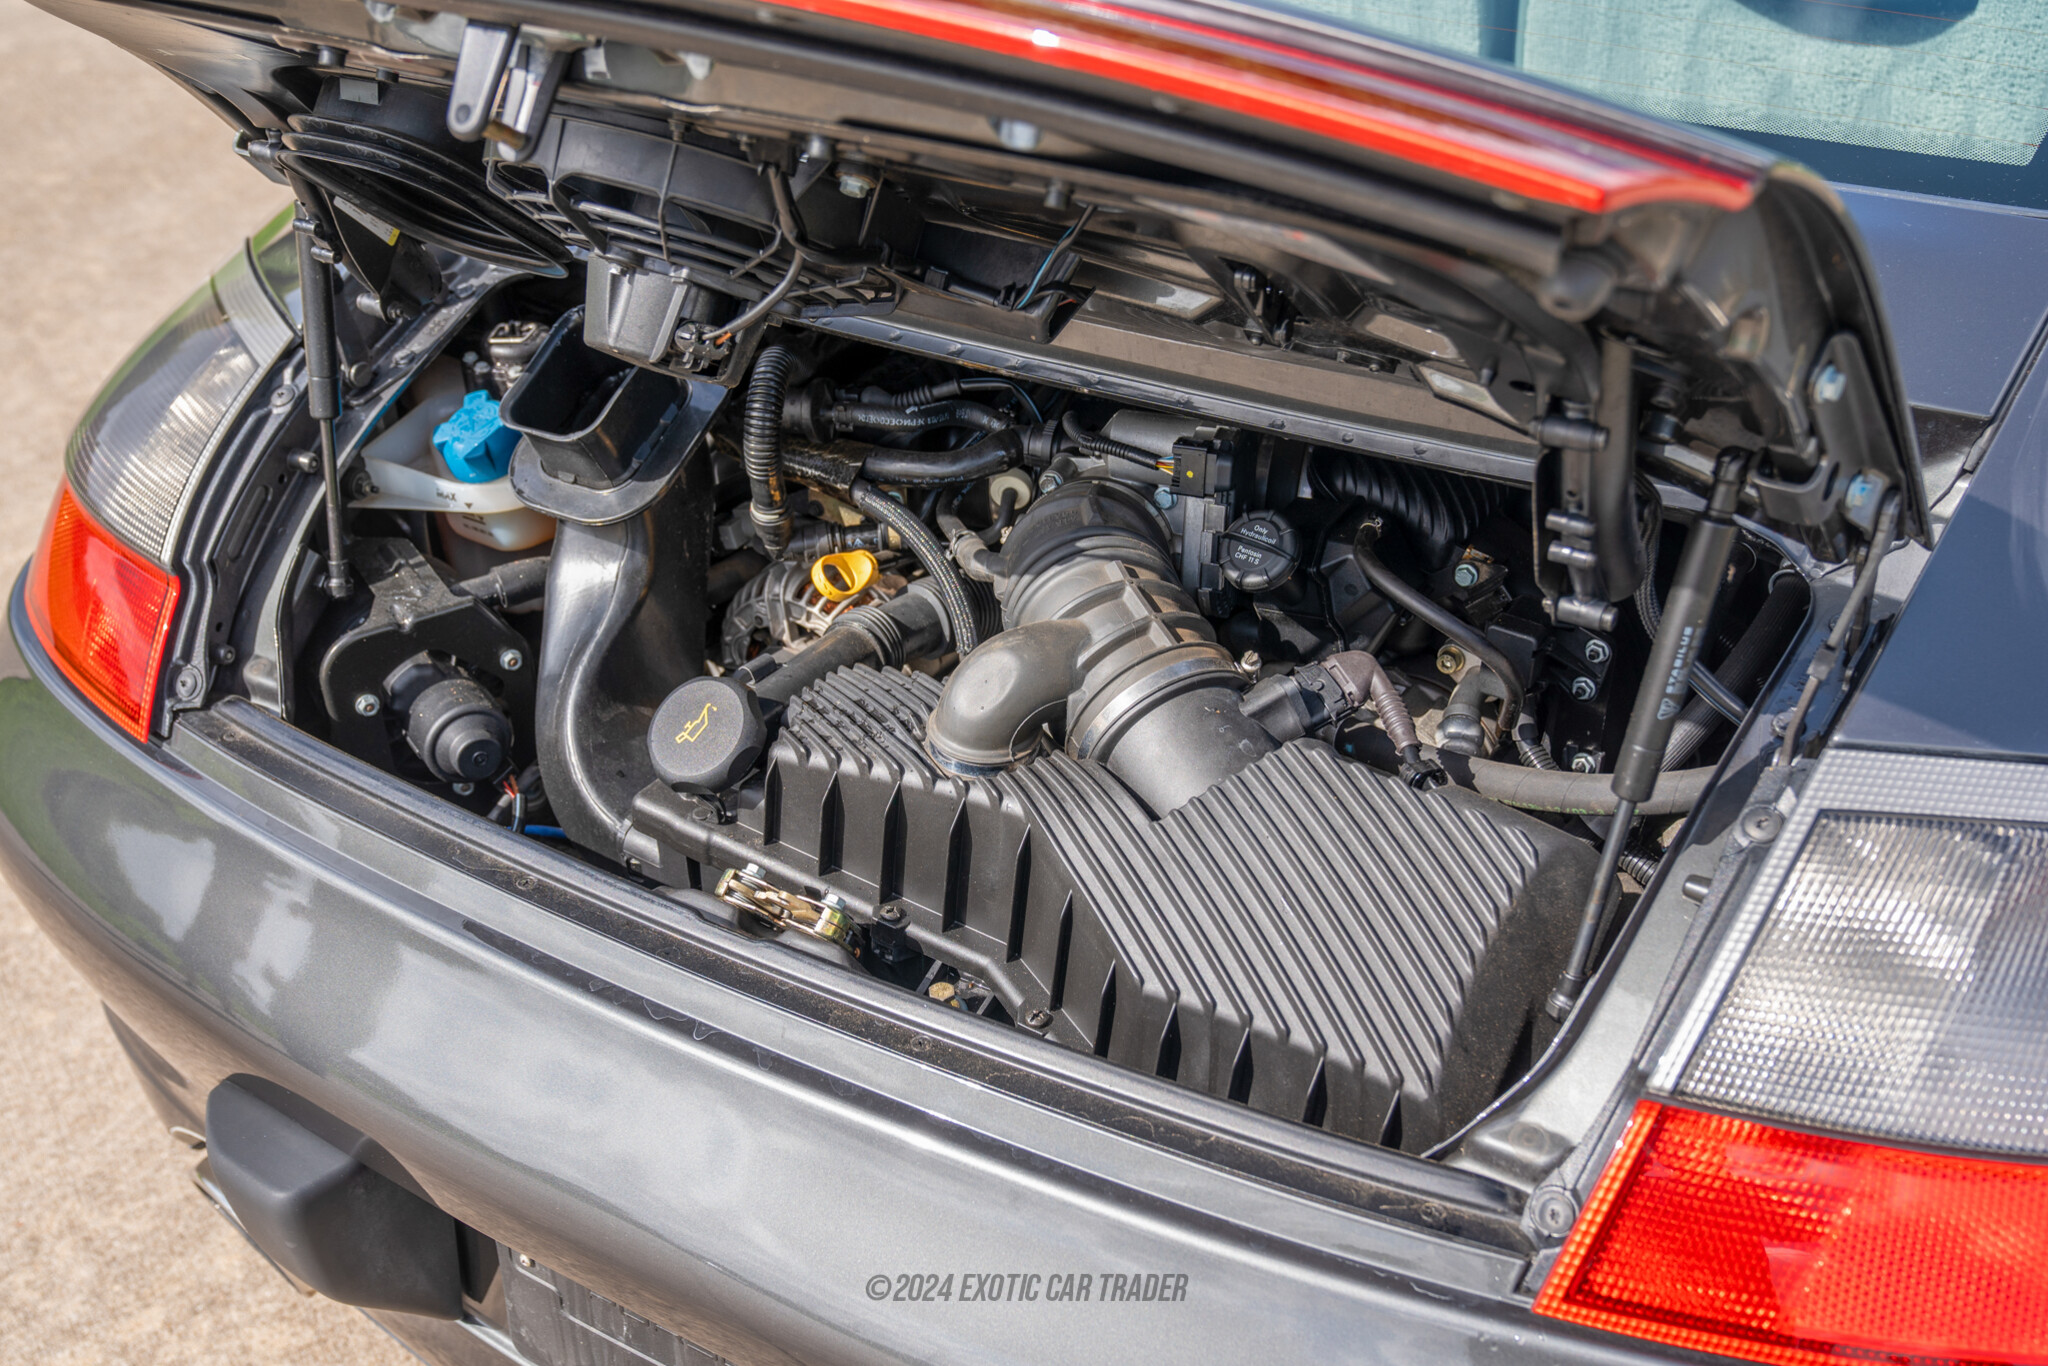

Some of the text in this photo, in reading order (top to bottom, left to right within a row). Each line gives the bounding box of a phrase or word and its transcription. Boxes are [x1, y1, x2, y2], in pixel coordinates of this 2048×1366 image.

[1240, 527, 1277, 545] Hydraulicoil
[1253, 524, 1269, 535] Only
[1234, 552, 1248, 561] CHF
[1237, 545, 1262, 558] Pentosin
[1665, 626, 1694, 694] STABILUS
